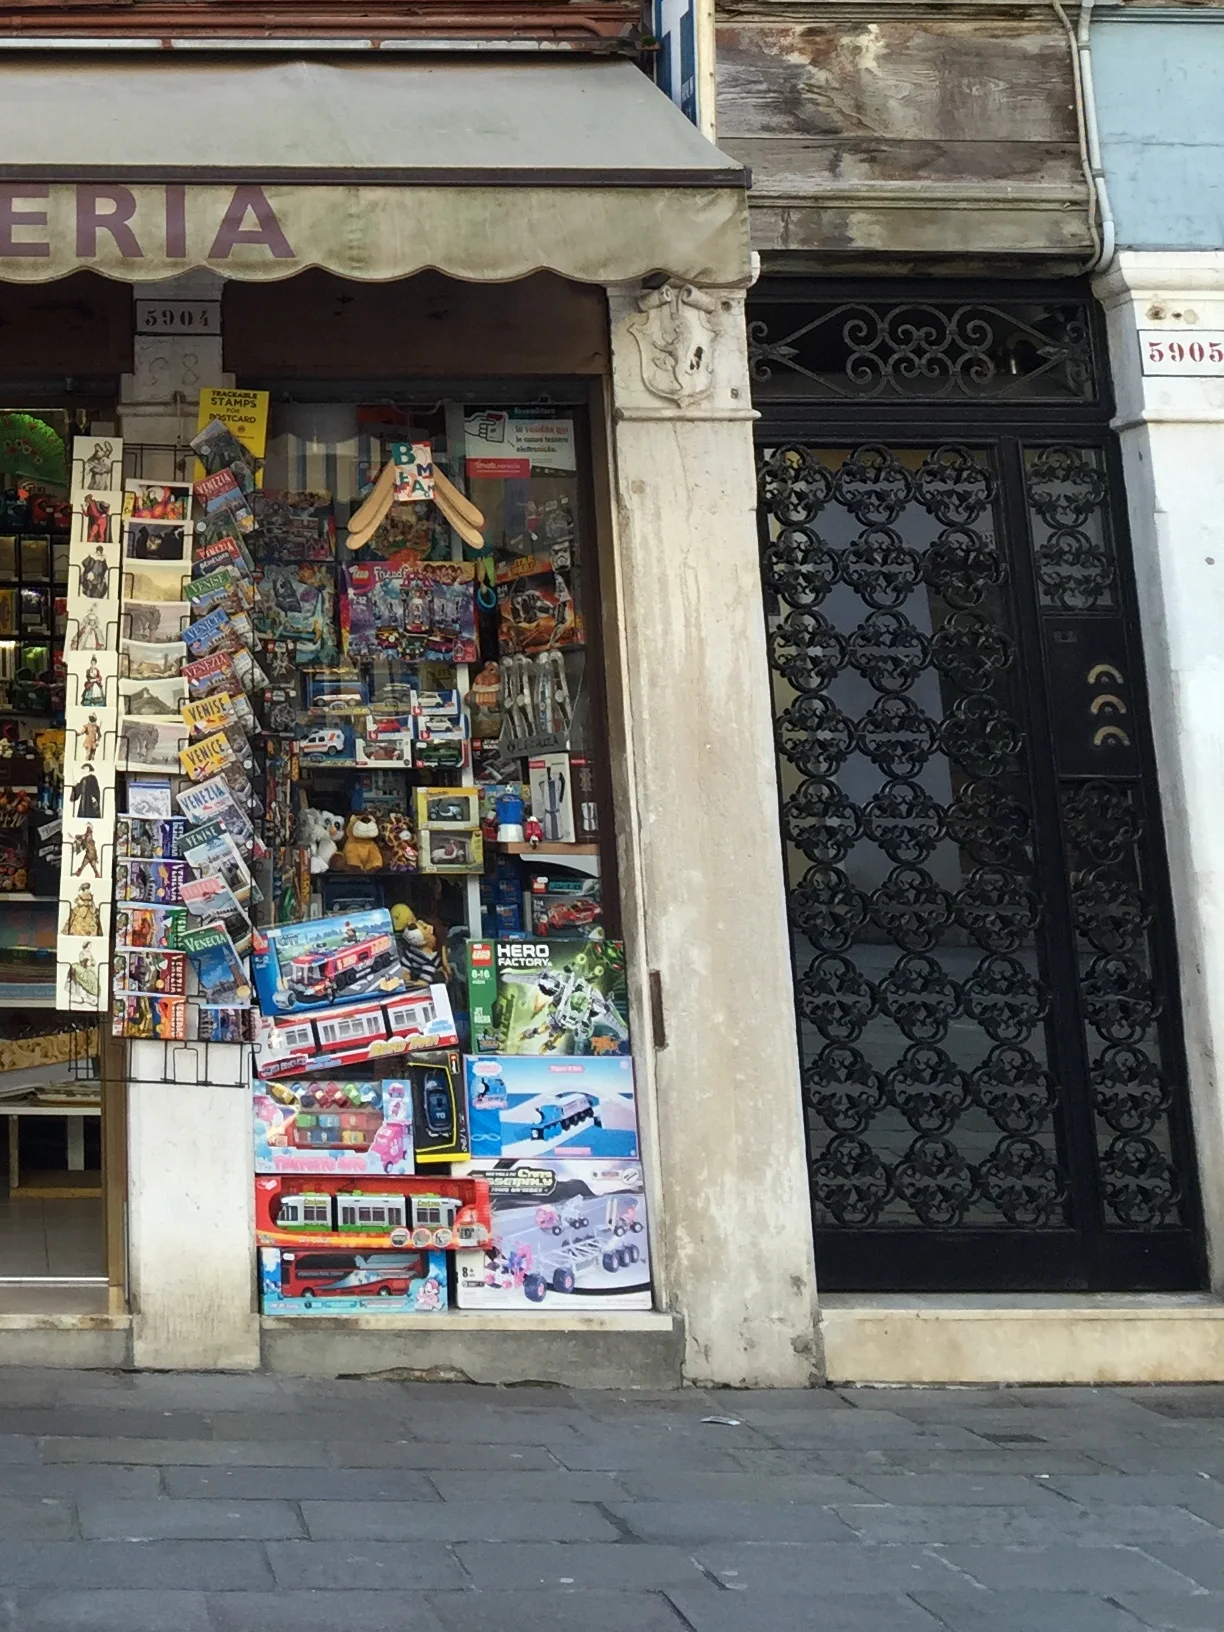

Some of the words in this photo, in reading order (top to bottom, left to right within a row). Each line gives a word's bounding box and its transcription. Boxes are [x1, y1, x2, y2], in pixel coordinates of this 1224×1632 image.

[144, 309, 210, 327] 5904
[1149, 341, 1224, 363] 5905
[211, 390, 258, 399] TRACEABLE
[211, 397, 257, 408] STAMPS
[208, 413, 257, 424] POSTCARD
[196, 471, 232, 495] VENEZIA
[190, 572, 226, 595] VENISE
[187, 611, 224, 639] VENICE
[185, 653, 228, 677] VENEZIA
[188, 697, 227, 722] VENISE
[186, 738, 225, 766] VENICE
[181, 783, 225, 812] VENEZIA
[184, 933, 228, 952] VENECIA
[497, 944, 550, 958] HERO
[497, 957, 551, 967] FACTORY
